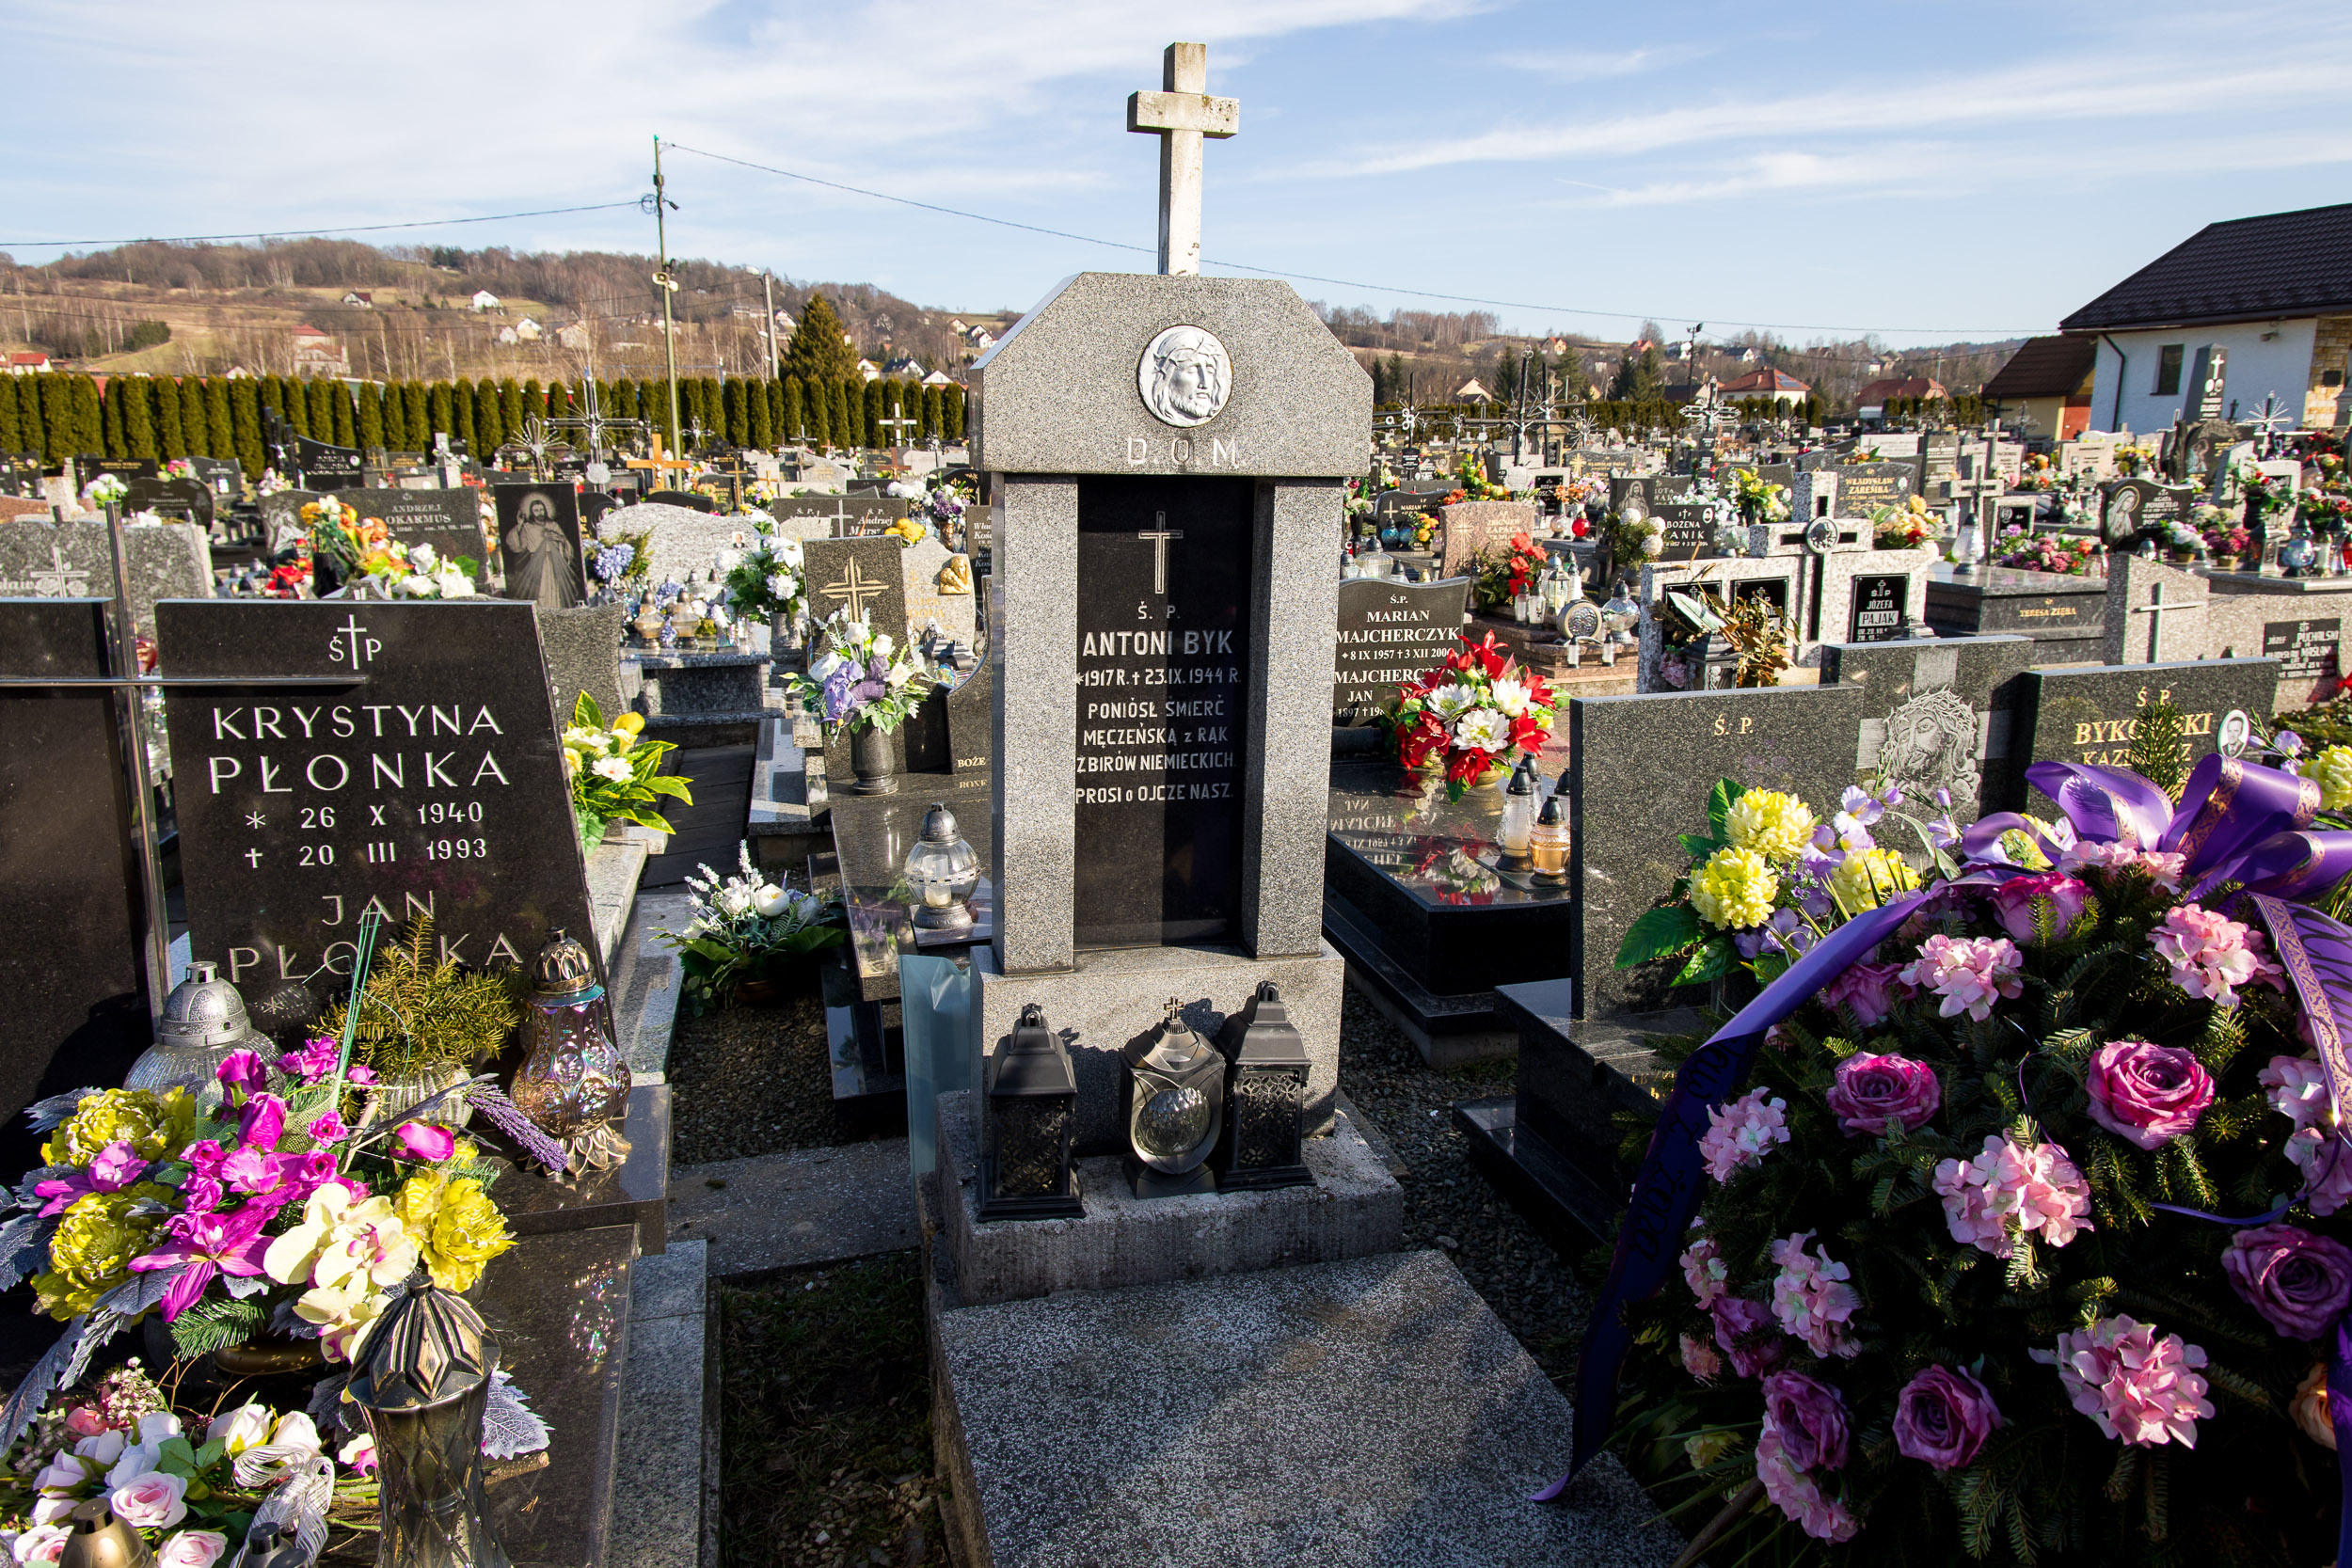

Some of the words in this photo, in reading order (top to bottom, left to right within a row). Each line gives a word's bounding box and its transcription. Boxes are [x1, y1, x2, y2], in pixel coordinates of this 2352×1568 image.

[392, 503, 440, 513] ANDRZEJ
[1867, 599, 1893, 610] JÓZEFA
[2019, 609, 2049, 617] TERESA
[1367, 610, 1430, 623] MARIAN
[1083, 630, 1173, 657] ANTONI
[1184, 629, 1233, 656] BYK
[1336, 627, 1460, 643] MAJCHERCZYK
[365, 638, 382, 661] P
[1350, 651, 1357, 660] 8
[1359, 650, 1371, 660] IX
[1374, 649, 1394, 659] 1957
[1405, 649, 1410, 658] 3
[1412, 648, 1428, 658] XII
[1347, 690, 1373, 703] JAN
[1089, 697, 1157, 720] PONIÓSŁ
[1166, 694, 1225, 717] ŚMIERĆ
[1338, 707, 1359, 718] 1897
[214, 705, 503, 740] KRYSTYNA
[1740, 717, 1754, 734] P.
[1083, 722, 1178, 749] MĘCZEŃSKĄ
[1198, 726, 1229, 744] RĄK
[958, 756, 986, 768] BOŻE
[209, 750, 510, 794] PŁONKA
[1075, 786, 1122, 804] PROSI
[1137, 784, 1185, 801] OJCZE
[300, 806, 335, 829] 26
[369, 804, 387, 826] X
[417, 801, 484, 825] 1940
[299, 844, 335, 866] 20
[367, 842, 396, 863] III
[426, 838, 486, 861] 1993
[321, 890, 435, 927] JAN
